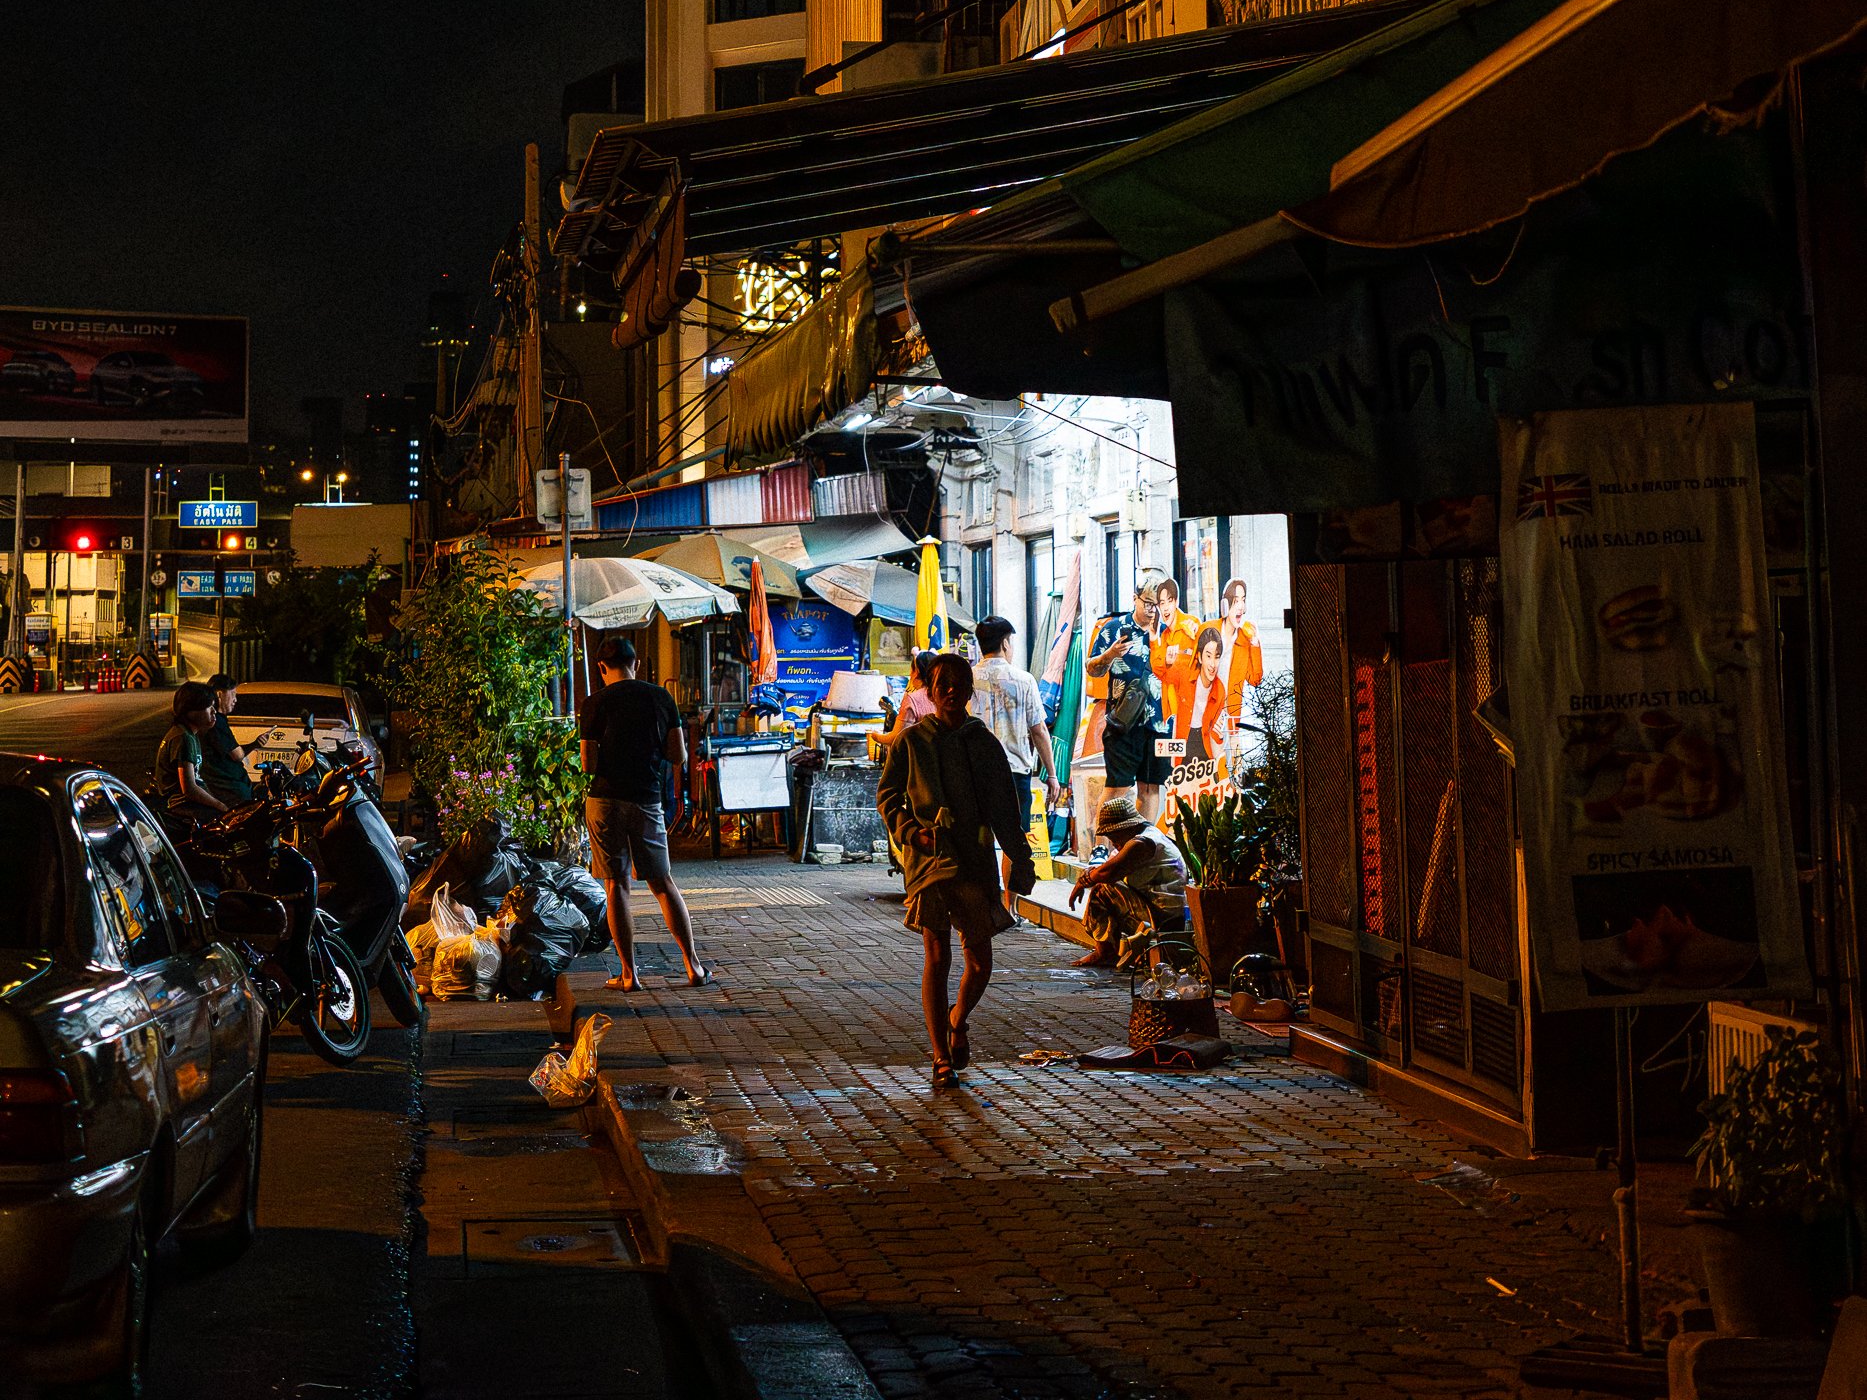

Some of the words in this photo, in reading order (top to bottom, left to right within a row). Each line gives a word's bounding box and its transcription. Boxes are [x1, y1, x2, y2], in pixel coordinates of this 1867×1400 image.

[32, 320, 74, 332] BYD
[78, 322, 166, 336] SEALION
[1642, 479, 1682, 492] MADE
[1684, 478, 1700, 490] TO
[193, 518, 216, 526] EASY
[221, 518, 243, 526] PASS
[123, 537, 131, 549] 3
[247, 537, 256, 549] 4
[1560, 532, 1600, 549] HAM
[1602, 530, 1659, 548] SALAD
[1663, 527, 1705, 544] ROLL
[1569, 690, 1673, 711] BREAKFAST
[1677, 688, 1725, 705] ROLL
[1172, 757, 1215, 786] อร่อย
[1587, 851, 1642, 871] SPICY
[1647, 846, 1734, 866] SAMOSA
